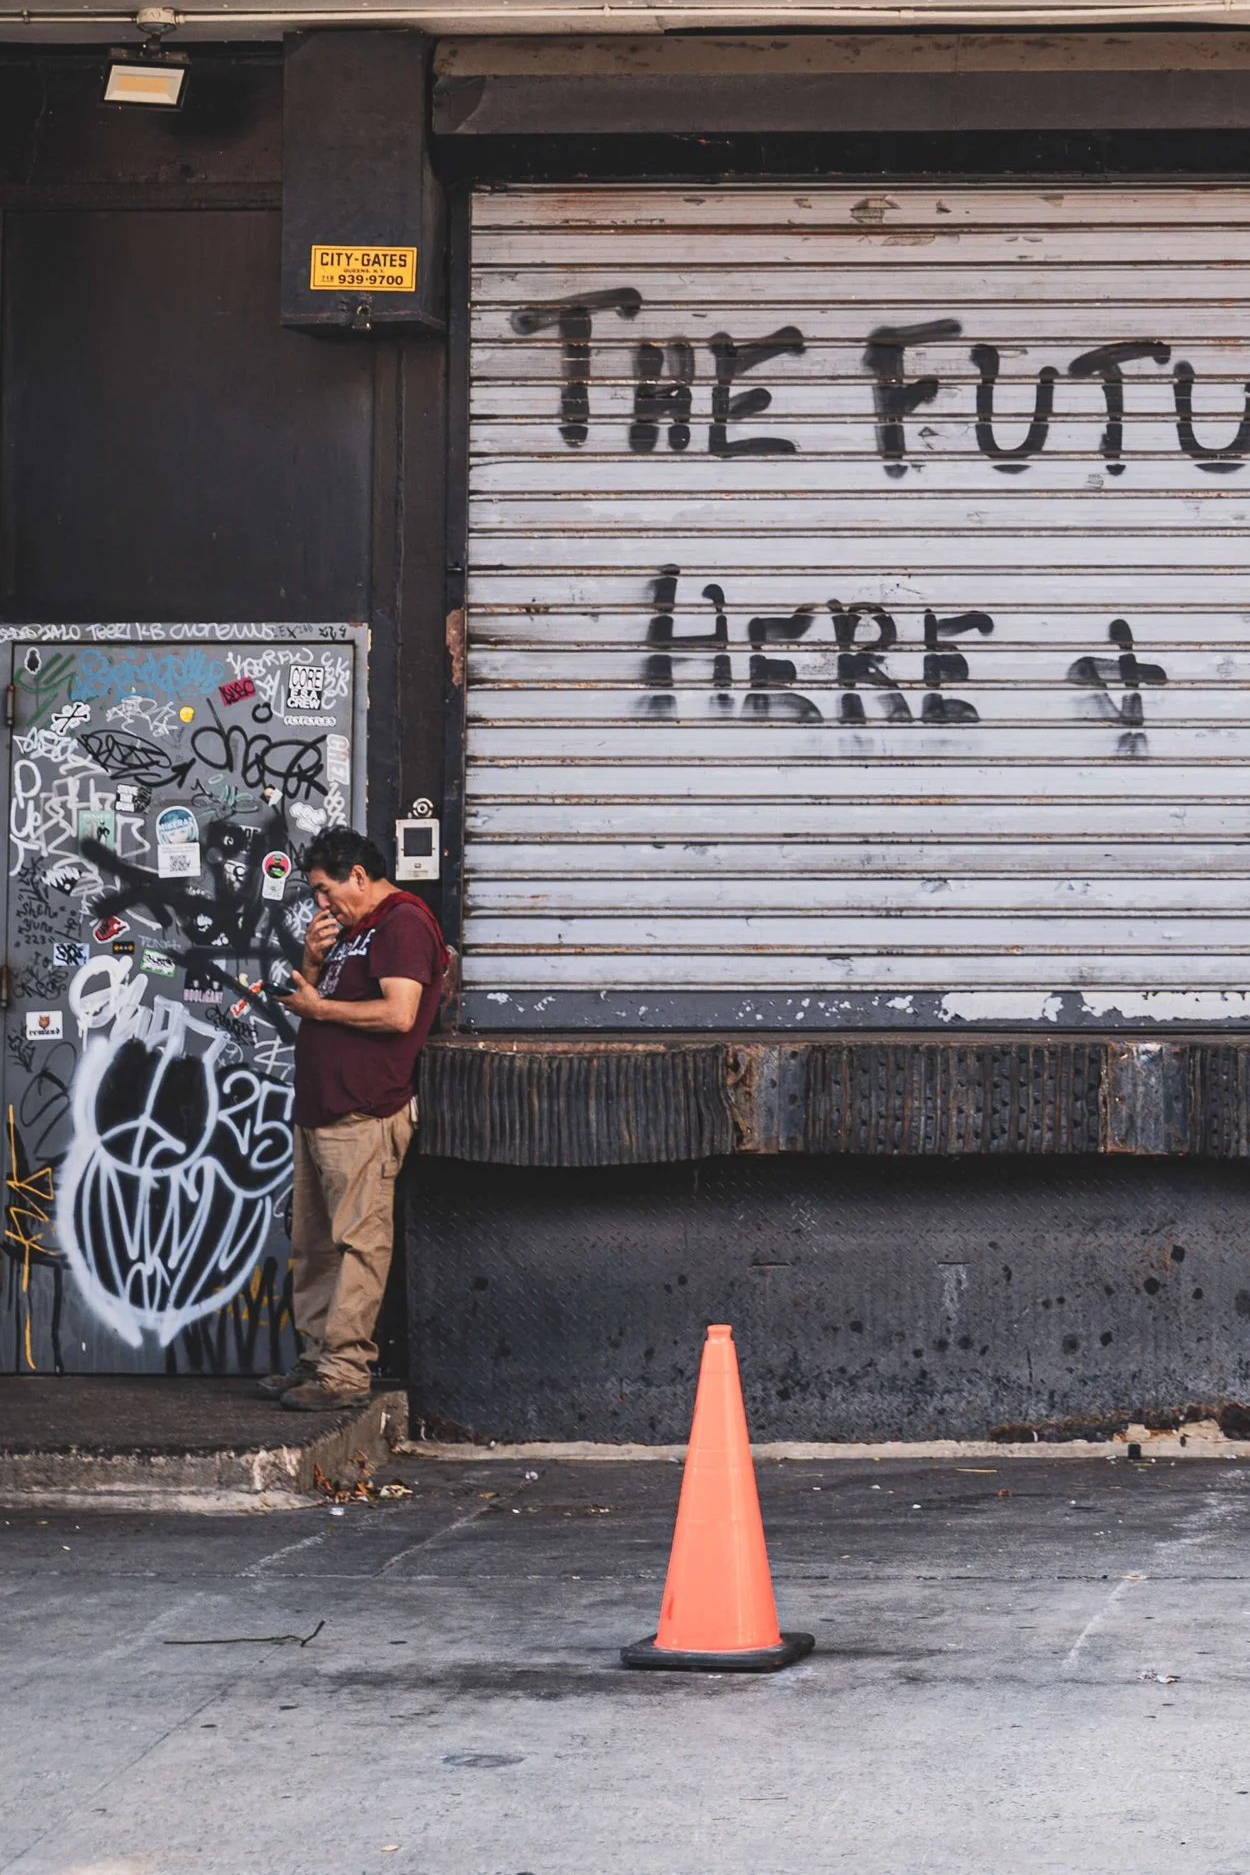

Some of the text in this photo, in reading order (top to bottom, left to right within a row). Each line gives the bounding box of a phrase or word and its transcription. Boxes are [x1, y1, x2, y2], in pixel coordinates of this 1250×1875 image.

[320, 252, 407, 268] CITY-GATES
[510, 287, 805, 459] THE
[632, 563, 995, 726] HERE
